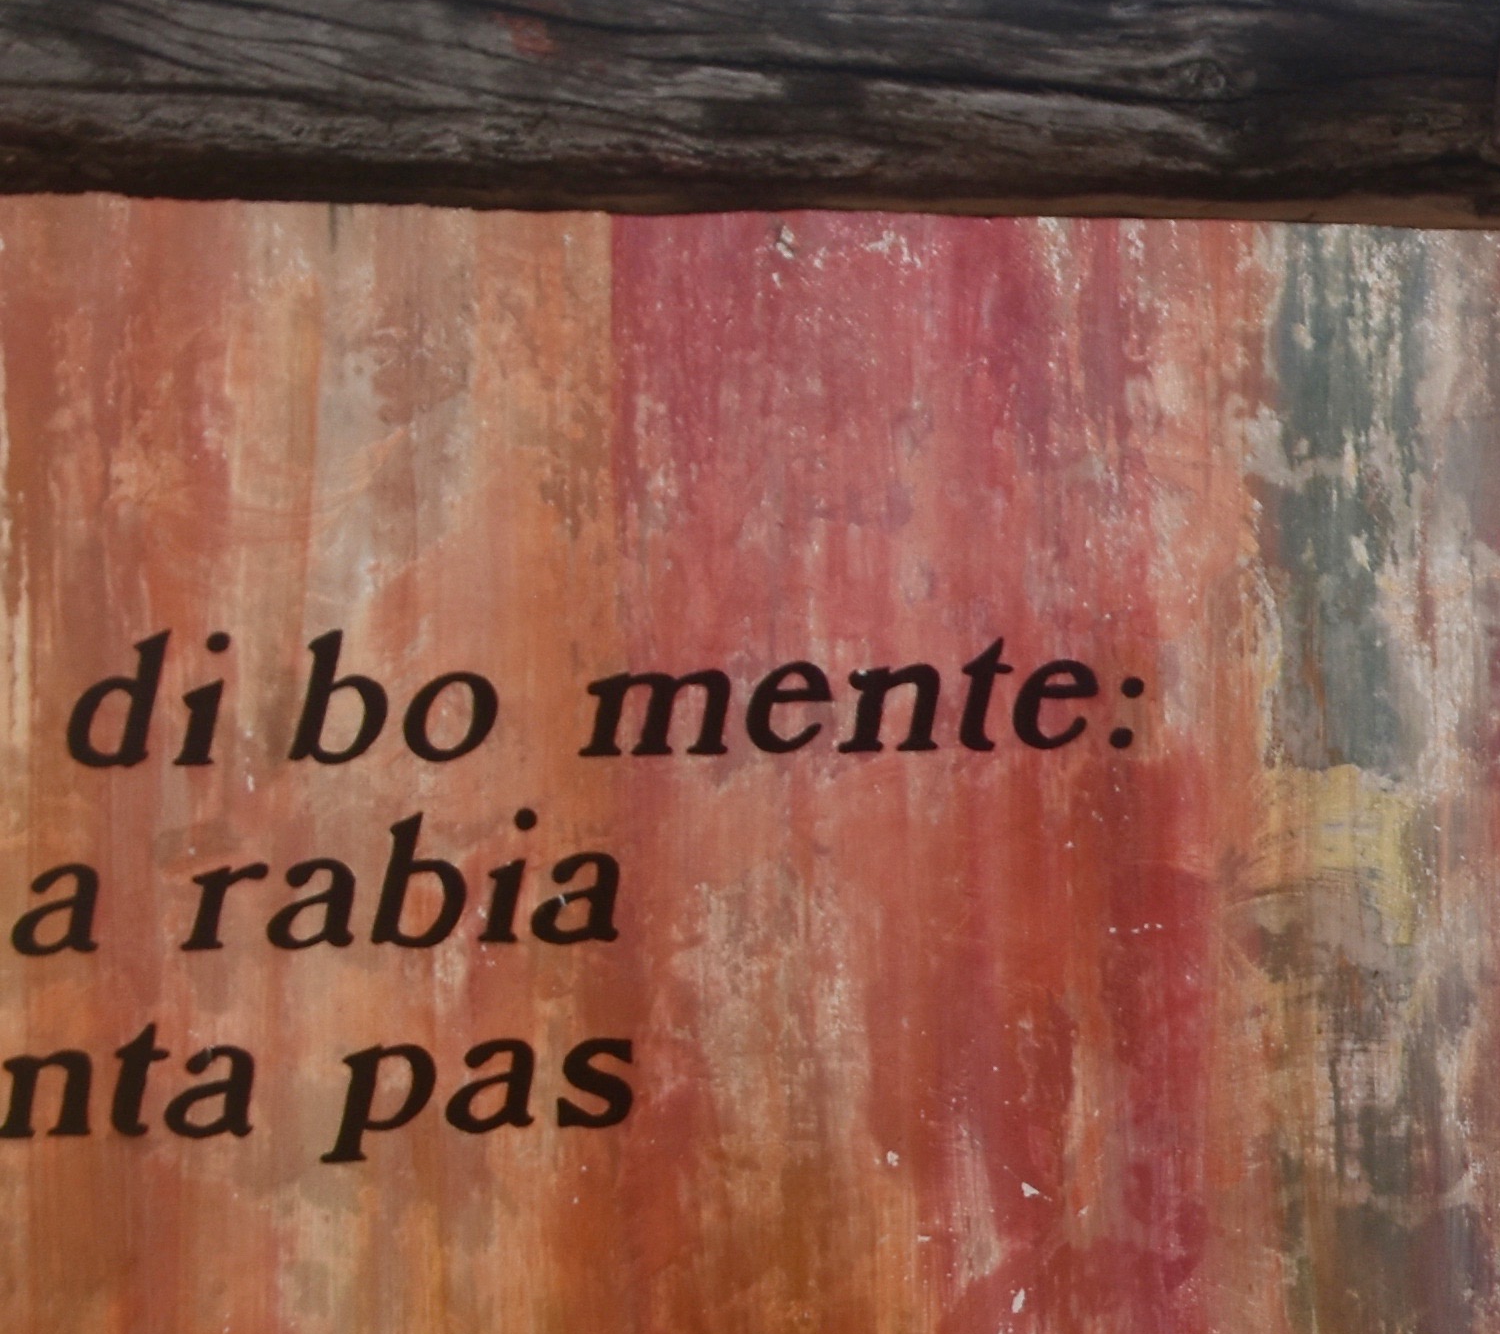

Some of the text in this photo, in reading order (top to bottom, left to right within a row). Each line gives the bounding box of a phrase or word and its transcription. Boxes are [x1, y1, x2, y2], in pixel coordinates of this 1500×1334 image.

[66, 629, 1147, 770] di bo mente:
[11, 808, 621, 957] a rabia
[0, 1023, 635, 1164] nta pas
